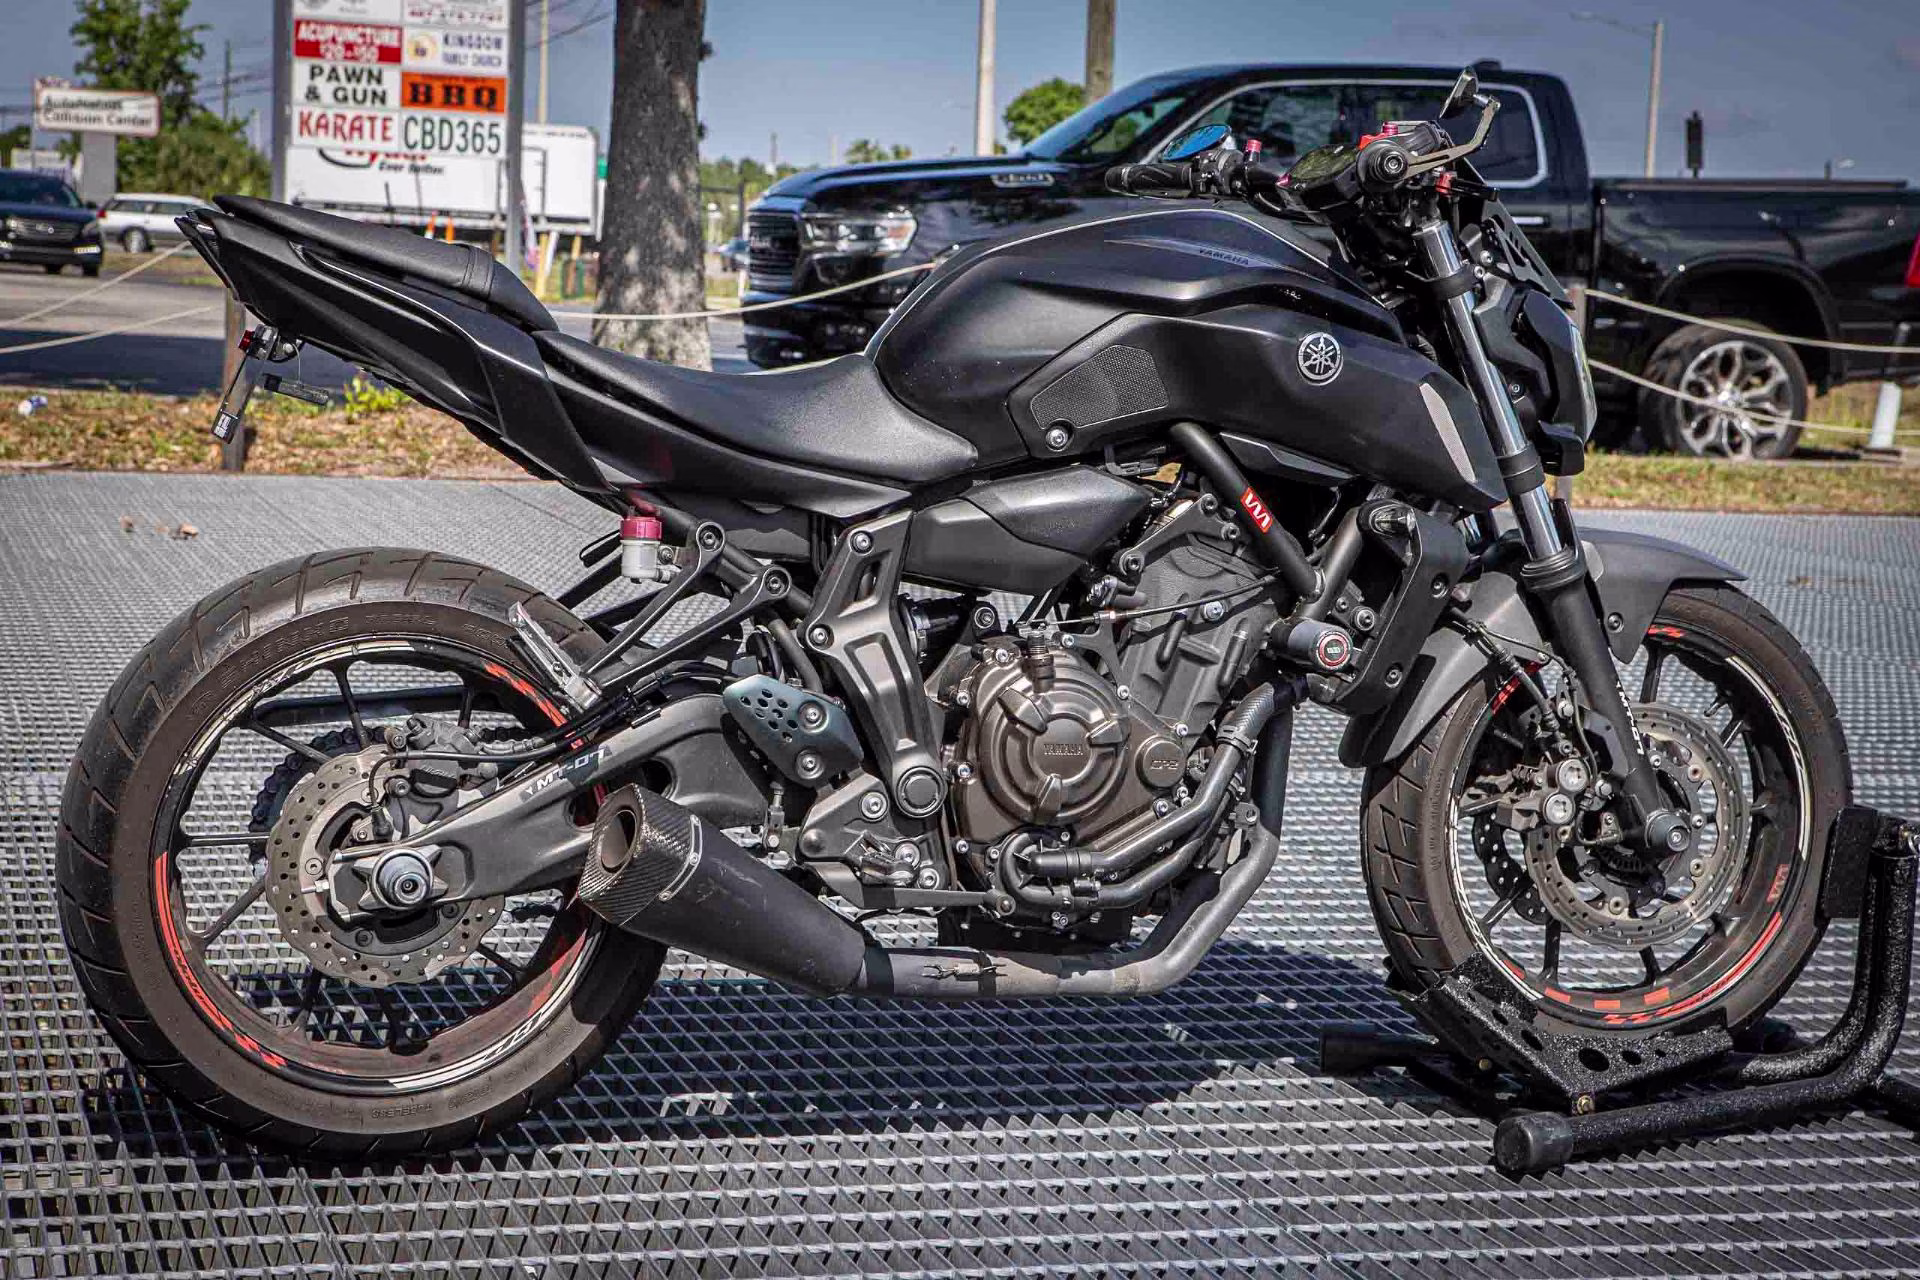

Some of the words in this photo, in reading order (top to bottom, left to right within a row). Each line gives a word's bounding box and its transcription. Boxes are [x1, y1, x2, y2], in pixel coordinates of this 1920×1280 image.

[443, 31, 503, 50] KINGDOM
[308, 64, 384, 85] PAWN
[305, 85, 321, 102] &
[332, 86, 388, 106] GUN
[408, 81, 498, 110] BBQ
[43, 109, 103, 123] Collision
[106, 112, 153, 126] Center
[299, 110, 394, 143] KARATE
[404, 115, 502, 154] CBD365
[1199, 248, 1249, 266] YAMAHA
[1043, 742, 1085, 756] YAMAHA
[536, 748, 606, 791] MT-07
